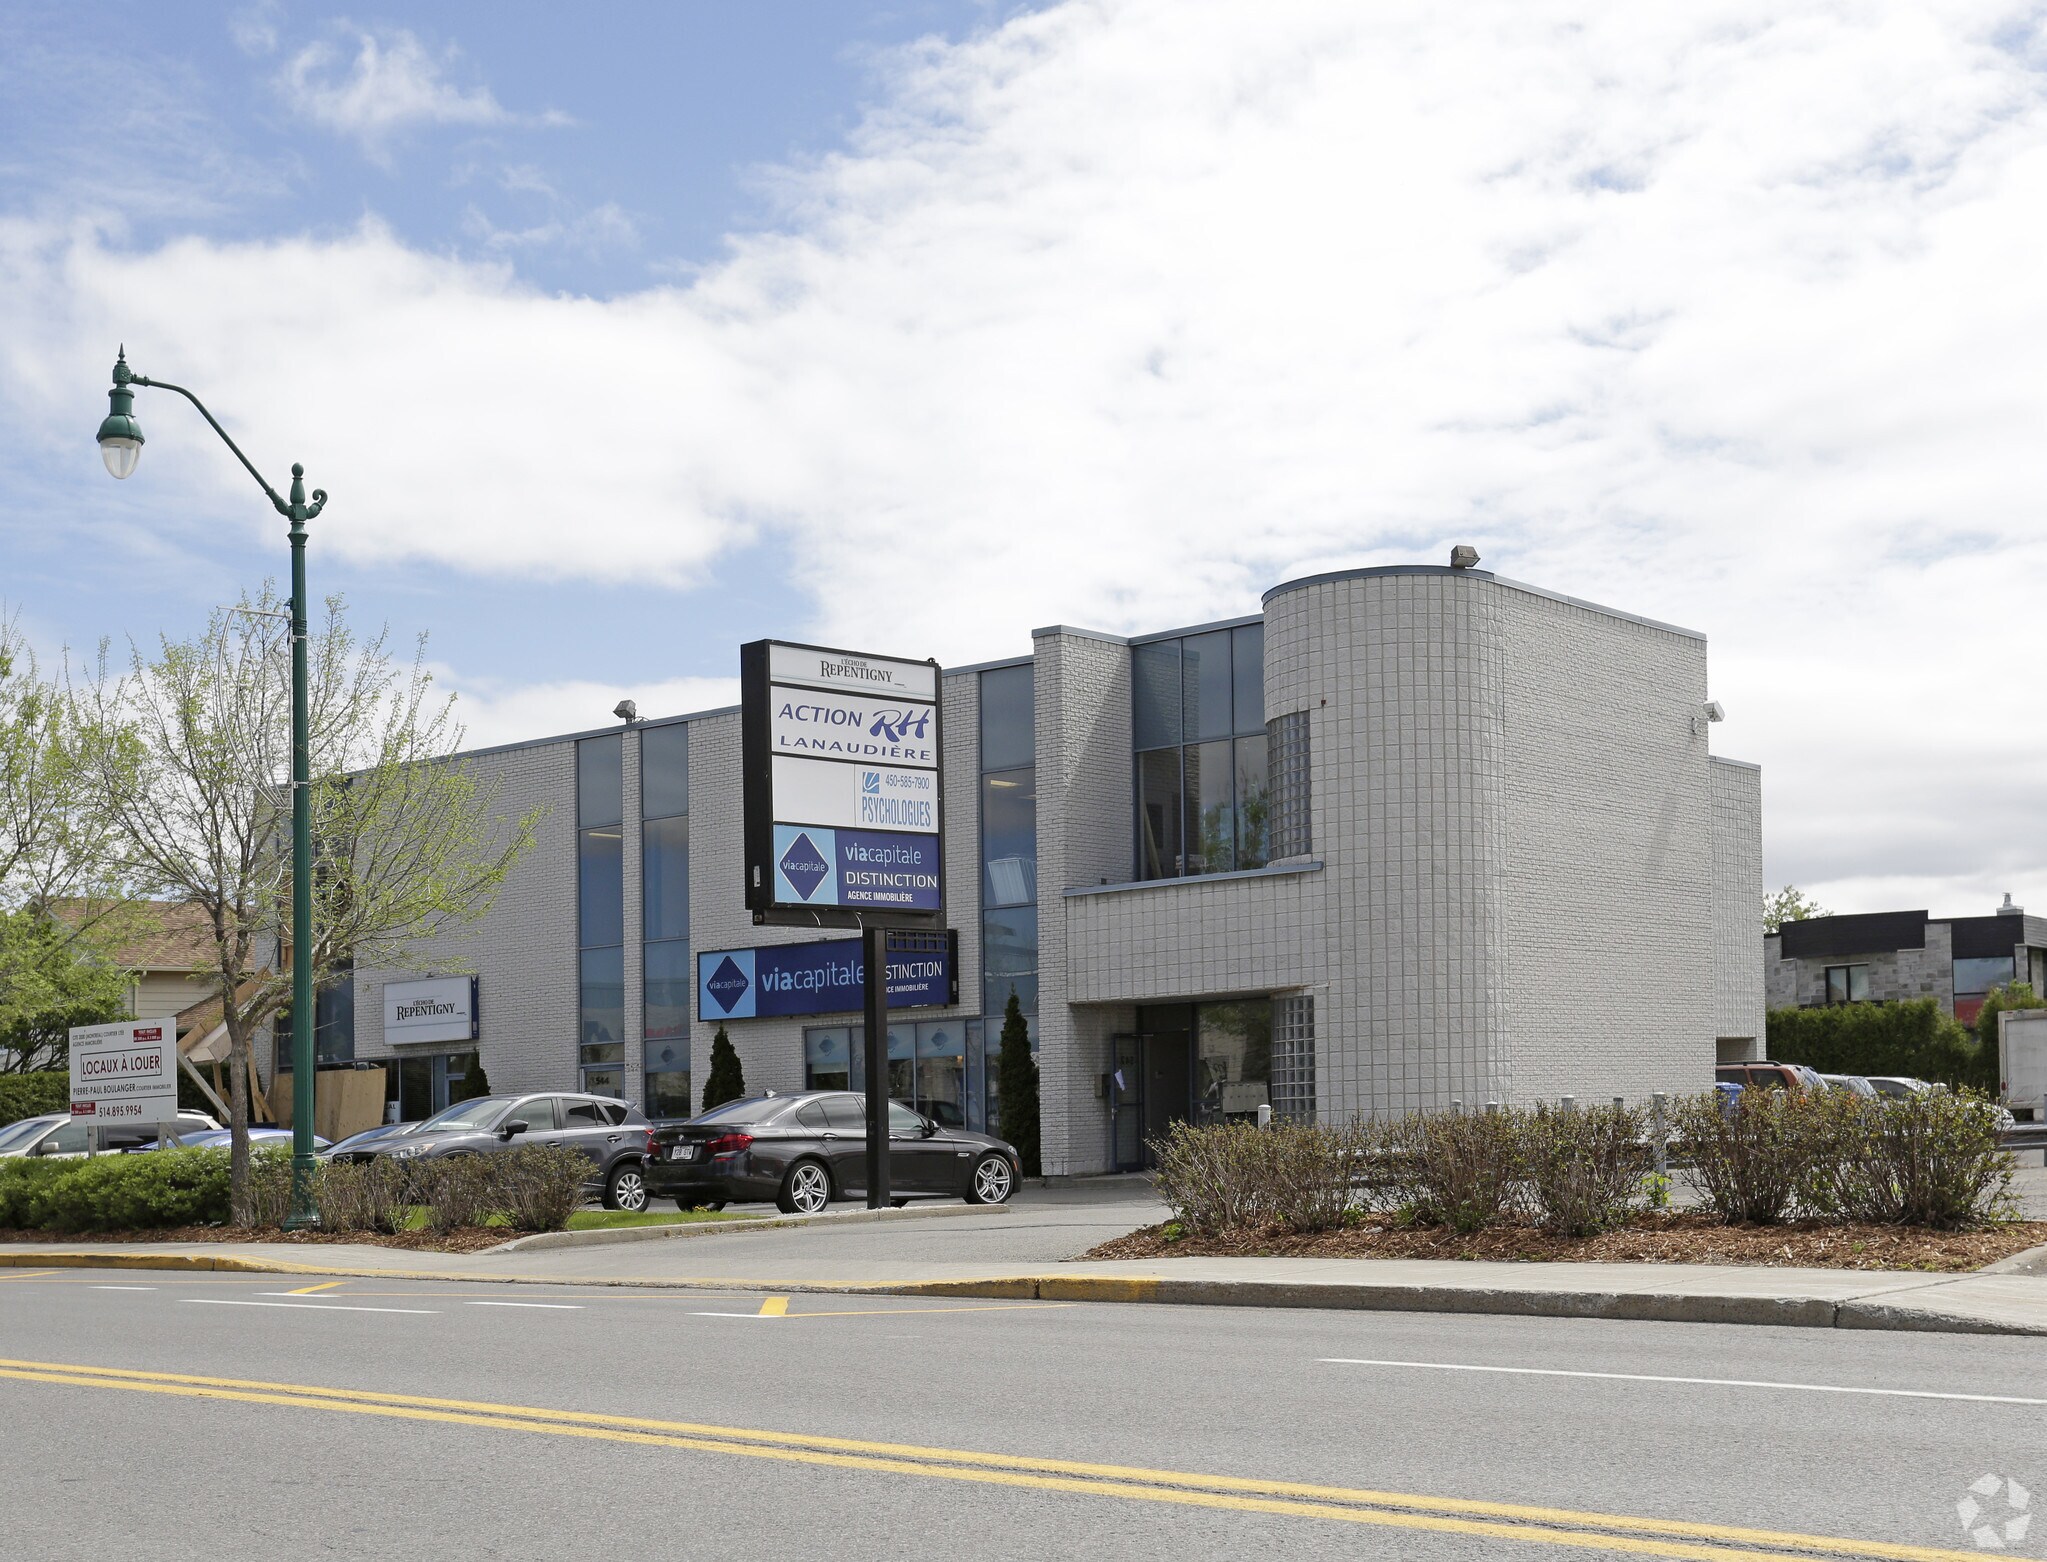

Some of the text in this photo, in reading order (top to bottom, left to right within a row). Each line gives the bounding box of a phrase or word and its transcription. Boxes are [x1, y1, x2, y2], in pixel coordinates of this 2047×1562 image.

[820, 660, 893, 683] REPENTIGNY
[778, 703, 930, 742] ACTION RH
[780, 735, 931, 760] LANAUDIÈRE
[885, 774, 929, 789] 450-585-7900
[862, 796, 931, 827] PSYCHOLOGUES
[845, 842, 921, 867] viacapitale
[782, 859, 825, 873] viacapitale
[846, 871, 937, 887] DISTINCTION
[847, 890, 914, 902] AGENCE IMMOBILIÈRE
[762, 960, 864, 993] viacapitale
[885, 961, 942, 980] STINCTION
[709, 978, 746, 990] viacapitale
[894, 983, 929, 993] IMMOBILIÈRE
[396, 1003, 455, 1020] REPENTIGNY
[82, 1053, 160, 1075] LOCAUX À LOUER
[73, 1086, 103, 1096] PIERRE-PAUL
[104, 1083, 136, 1093] BOULANGER
[99, 1105, 142, 1117] 514.895.9954
